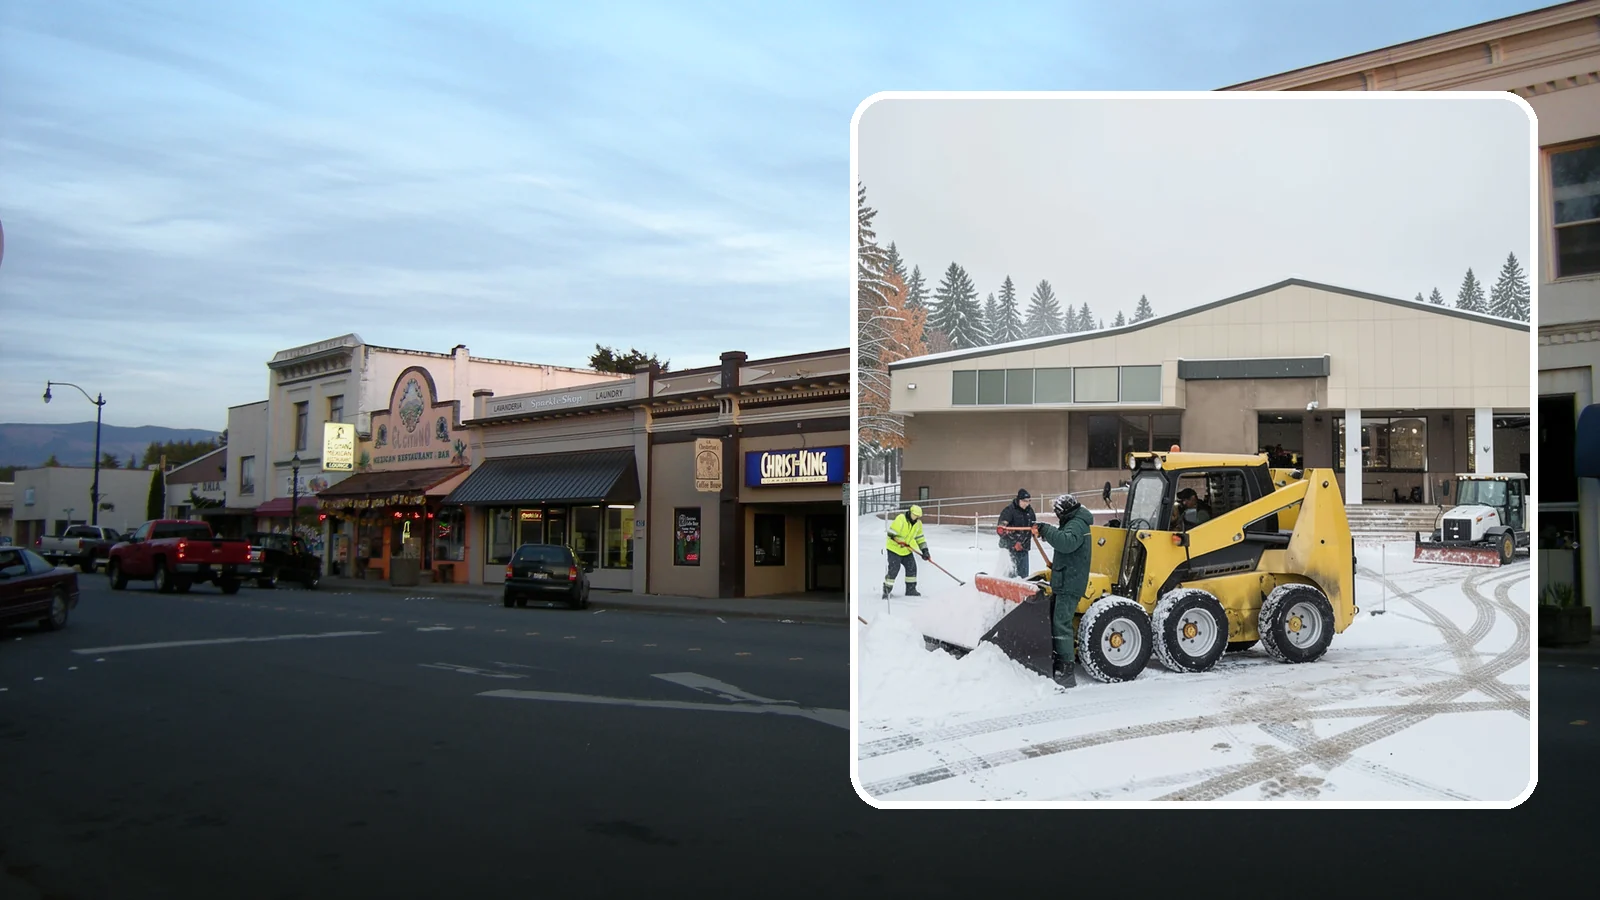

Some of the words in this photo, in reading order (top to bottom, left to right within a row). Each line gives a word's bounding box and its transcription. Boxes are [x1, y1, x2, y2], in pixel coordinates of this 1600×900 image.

[595, 389, 624, 400] LAUNDRY
[493, 402, 523, 413] LAVANDERIA
[530, 398, 560, 410] Sparkle
[561, 394, 582, 406] Shop
[373, 455, 397, 464] MEXICAN
[397, 451, 434, 462] RESTAURANT
[438, 450, 450, 459] BAR
[799, 449, 828, 476] KING
